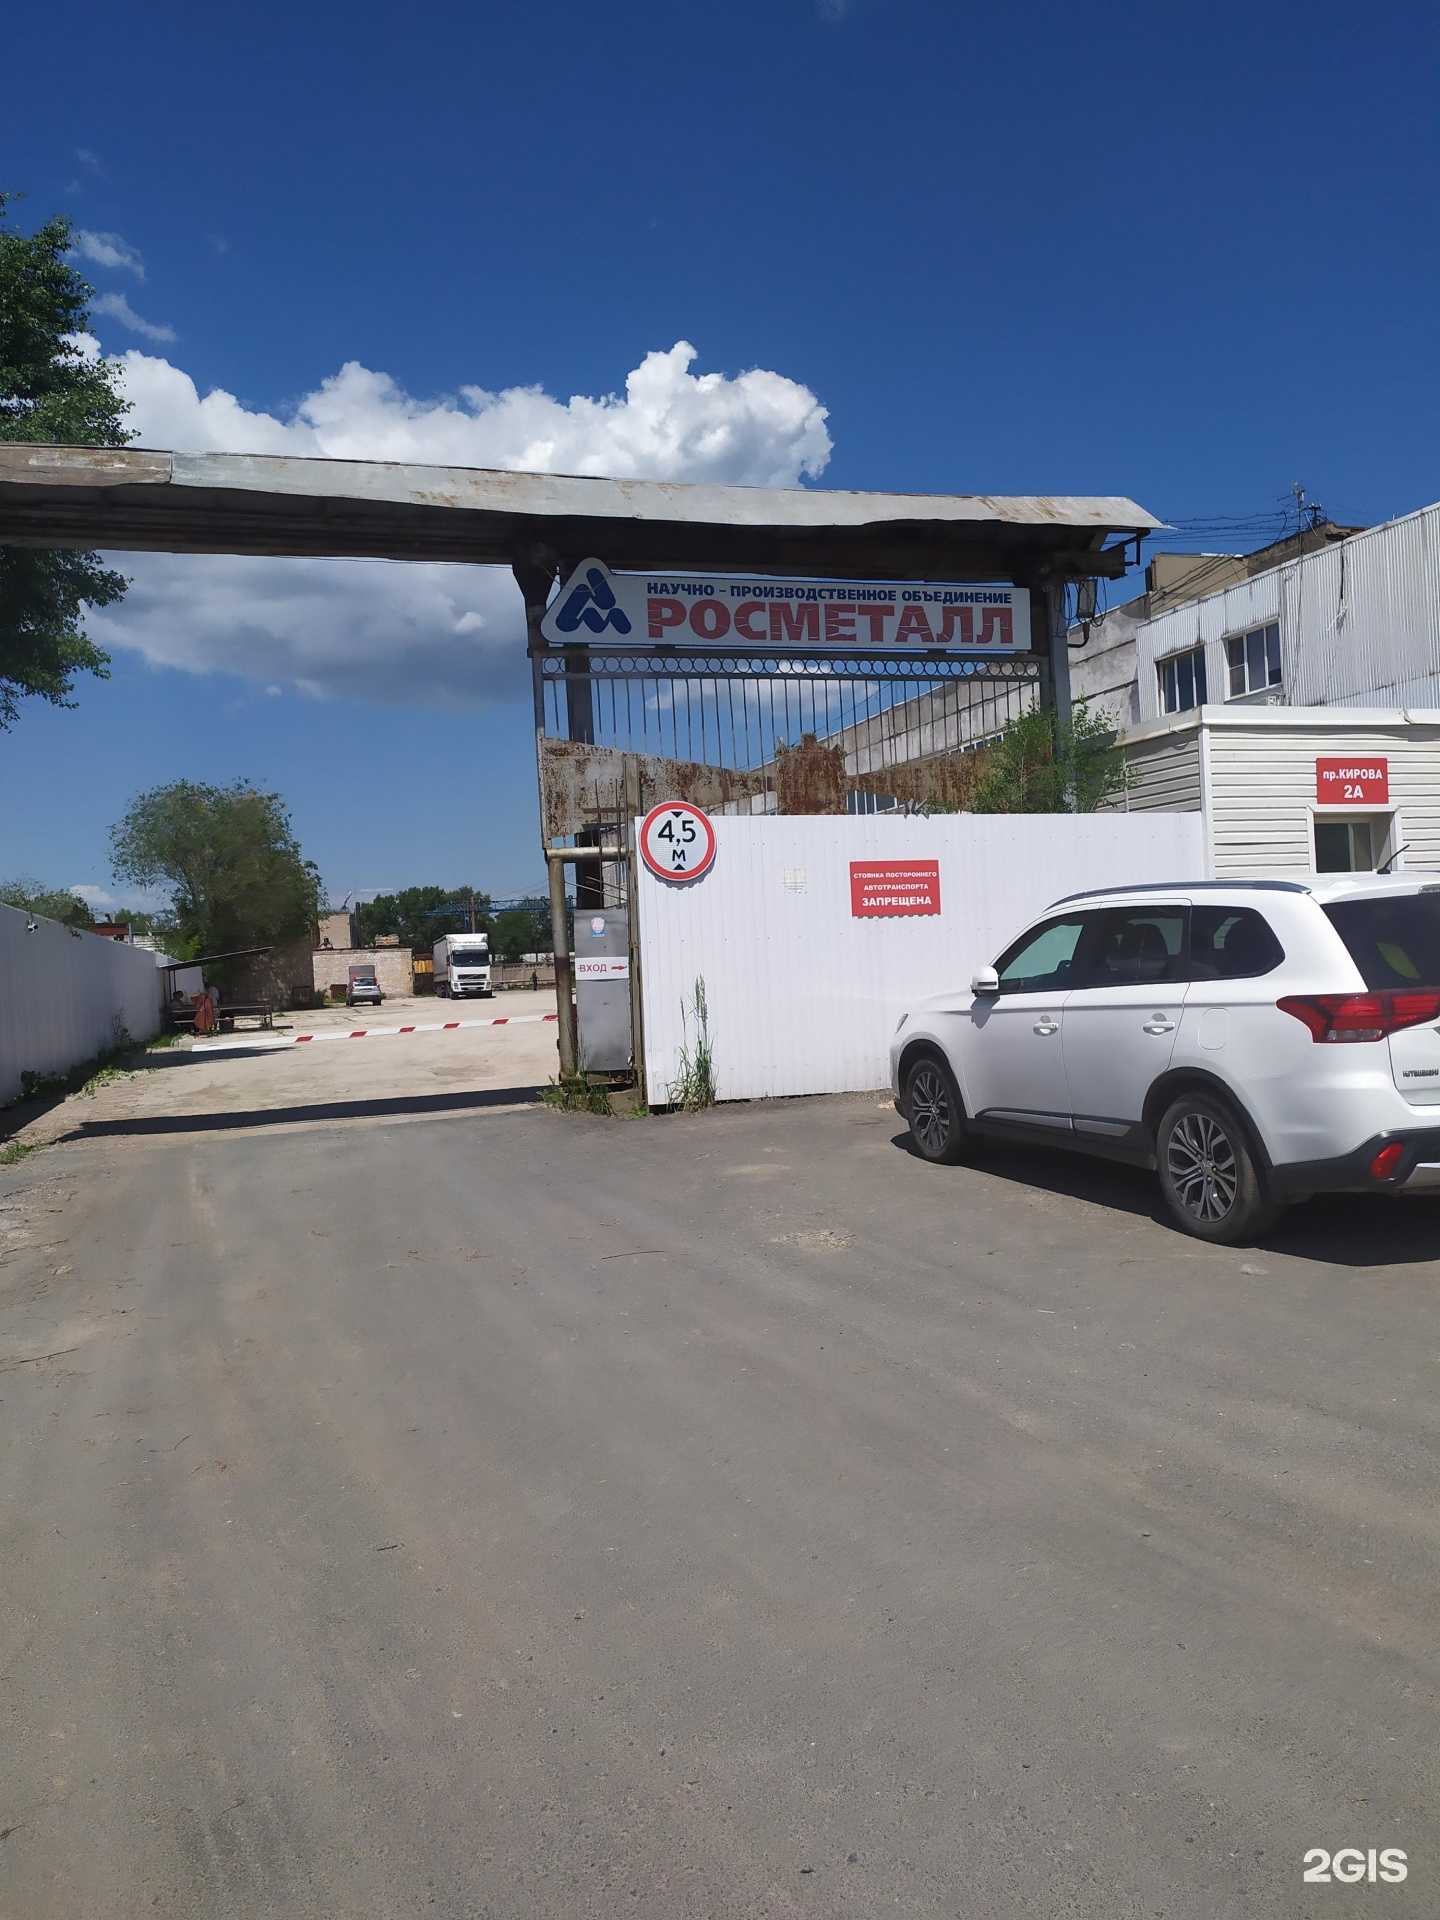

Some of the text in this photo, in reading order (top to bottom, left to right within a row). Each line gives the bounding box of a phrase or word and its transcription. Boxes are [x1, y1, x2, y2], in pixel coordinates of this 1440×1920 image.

[647, 582, 715, 596] НАУЧНО
[730, 585, 897, 602] ПРОИЗВОДСТВЕННОЕ
[901, 590, 1012, 605] ОБЪЕДИНЕНИЕ
[647, 597, 1014, 644] РОСМЕТАЛЛ
[1343, 784, 1364, 799] 2А
[657, 819, 697, 847] 4,5
[885, 871, 937, 879] ПОСТОРОННЕГО
[863, 883, 929, 891] АВТОТРАНСПОРТА
[861, 896, 932, 907] ЗАПРЕЩЕНА
[579, 963, 608, 973] ВХОД
